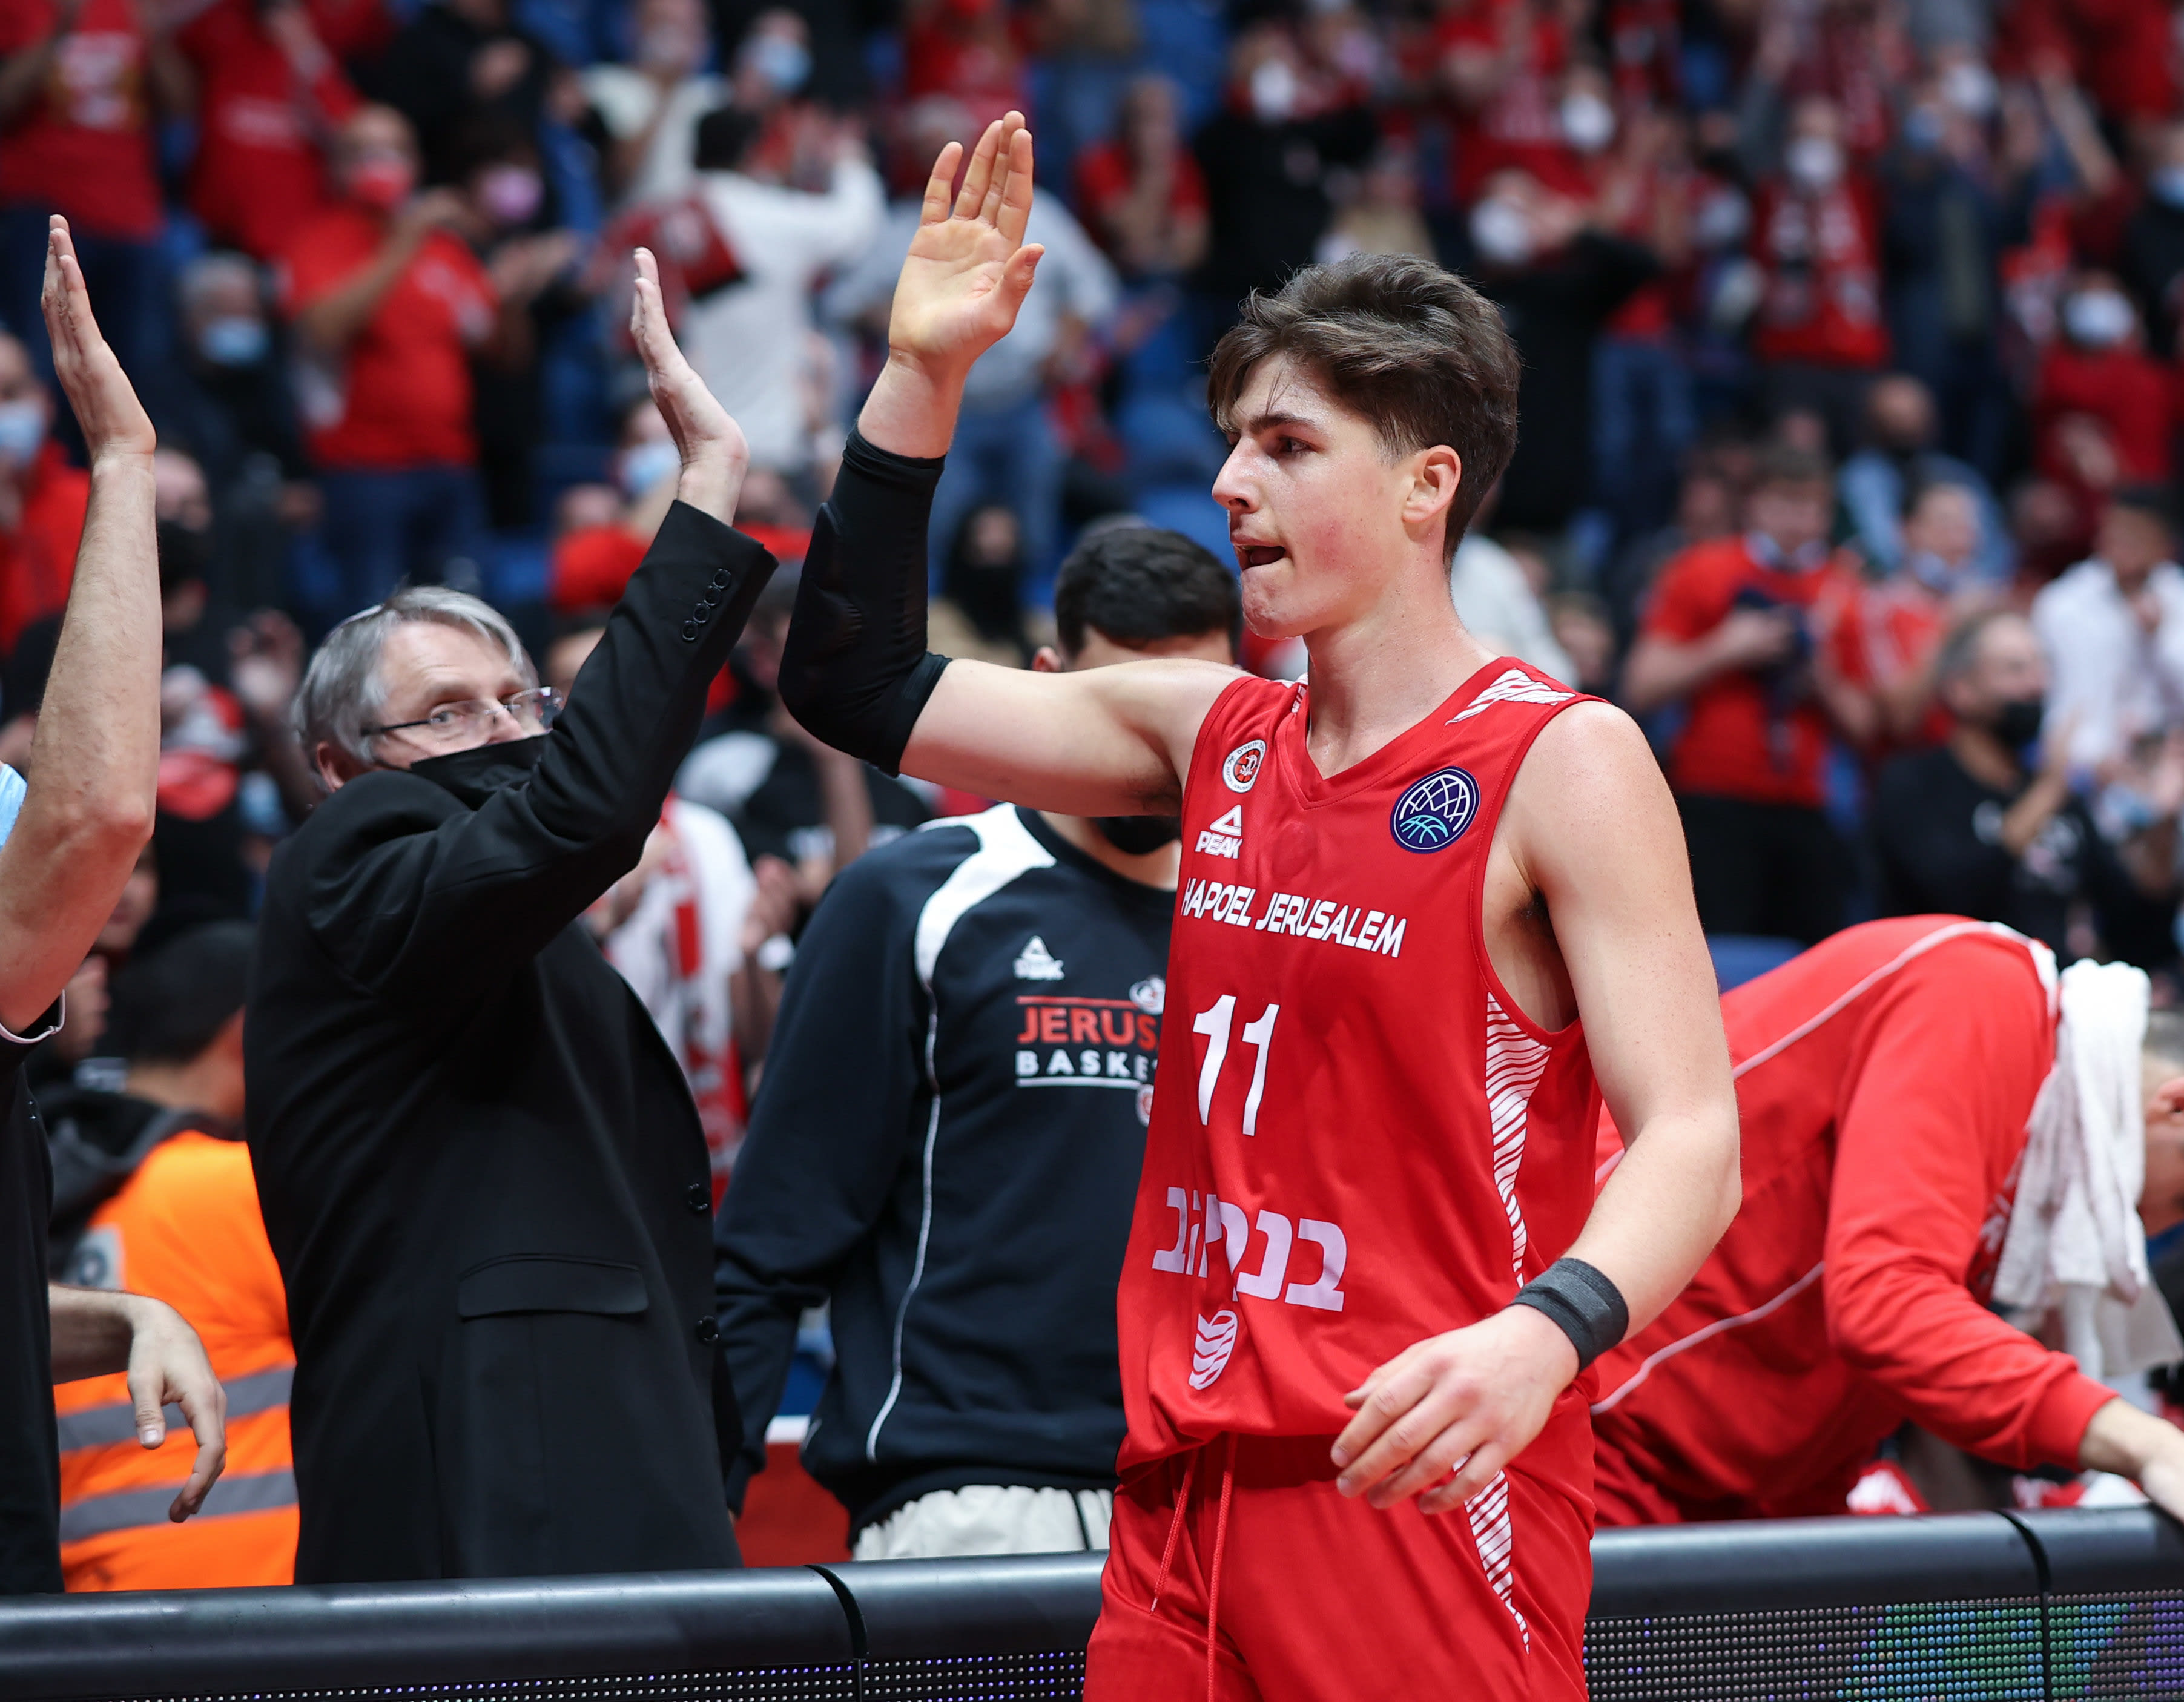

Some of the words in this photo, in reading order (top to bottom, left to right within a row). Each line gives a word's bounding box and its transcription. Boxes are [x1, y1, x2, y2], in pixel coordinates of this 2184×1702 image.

[1195, 830, 1243, 859] PEAK
[1181, 877, 1256, 927] HAPOEL
[1255, 892, 1407, 958] JERUSALEM
[1015, 1049, 1158, 1083] BASKE
[1192, 994, 1281, 1136] 11
